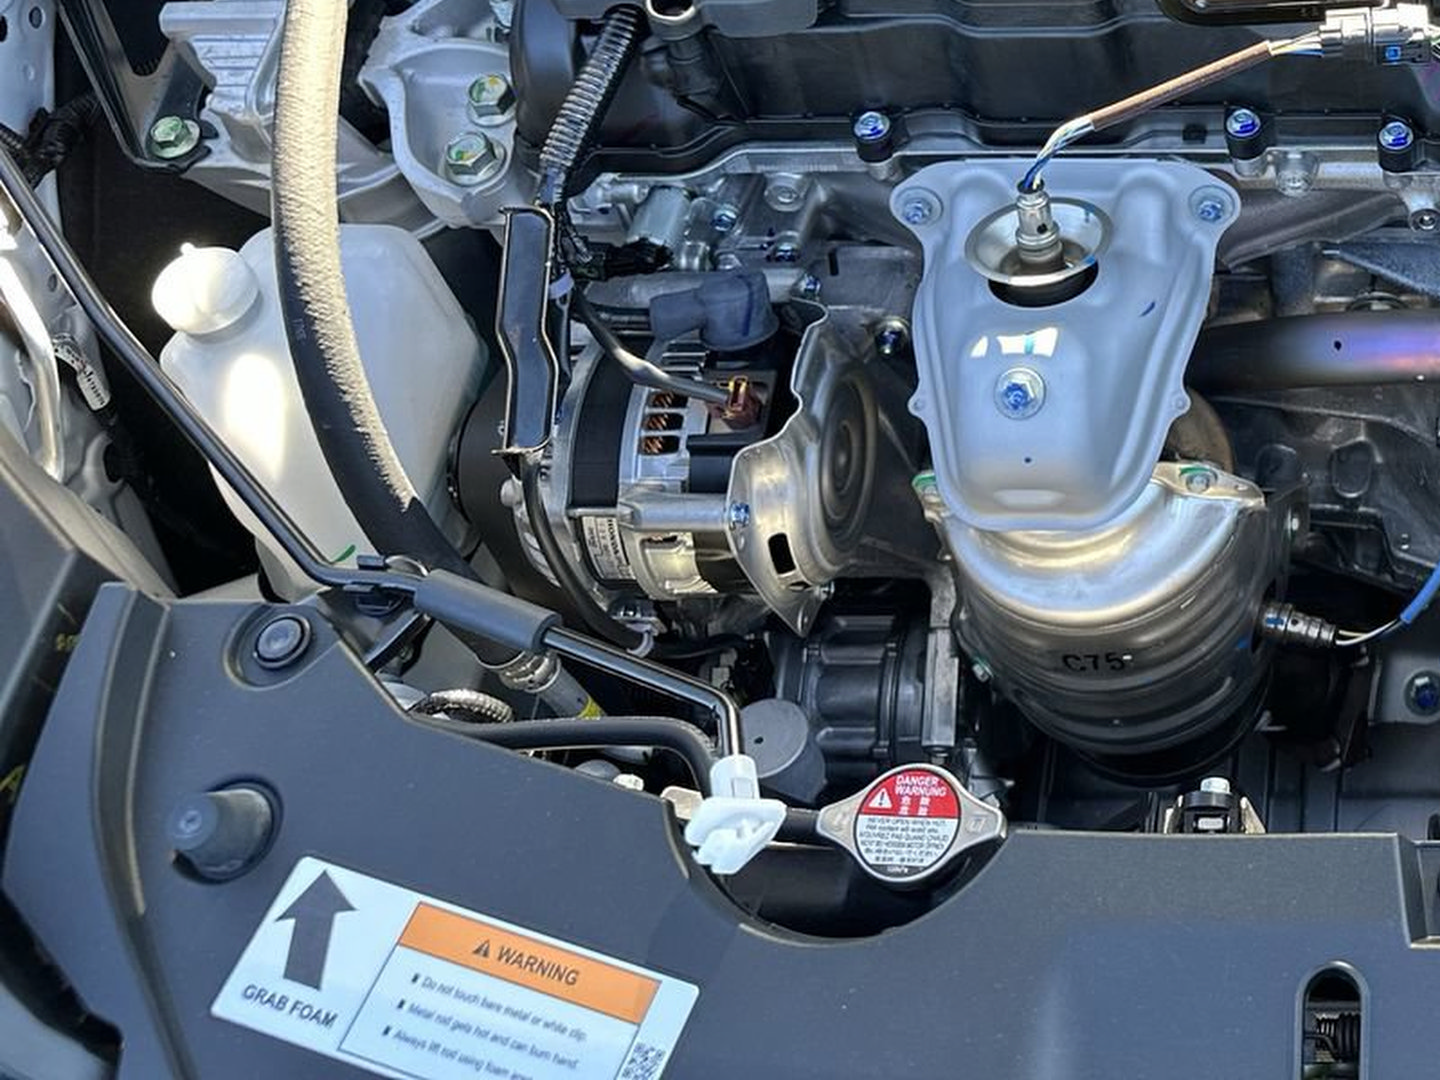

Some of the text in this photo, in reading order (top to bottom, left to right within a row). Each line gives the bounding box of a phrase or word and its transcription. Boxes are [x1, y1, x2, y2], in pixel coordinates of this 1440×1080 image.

[895, 775, 939, 786] DANGER
[497, 945, 580, 986] WARNING
[242, 984, 338, 1030] GRAB FOAM
[421, 976, 435, 991] Do
[436, 982, 454, 995] not
[453, 988, 480, 1005] touch
[481, 997, 503, 1013] bare
[503, 1005, 532, 1022] metal
[531, 1015, 543, 1025] or
[543, 1018, 568, 1035] white
[393, 1028, 427, 1050] Always
[428, 1040, 441, 1054] lift
[457, 1053, 484, 1072] using
[485, 1061, 510, 1076] foam
[407, 1003, 435, 1019] Metal
[473, 1025, 490, 1039] hot
[490, 1033, 511, 1047] and
[510, 1039, 529, 1052] can
[529, 1045, 551, 1060] burn
